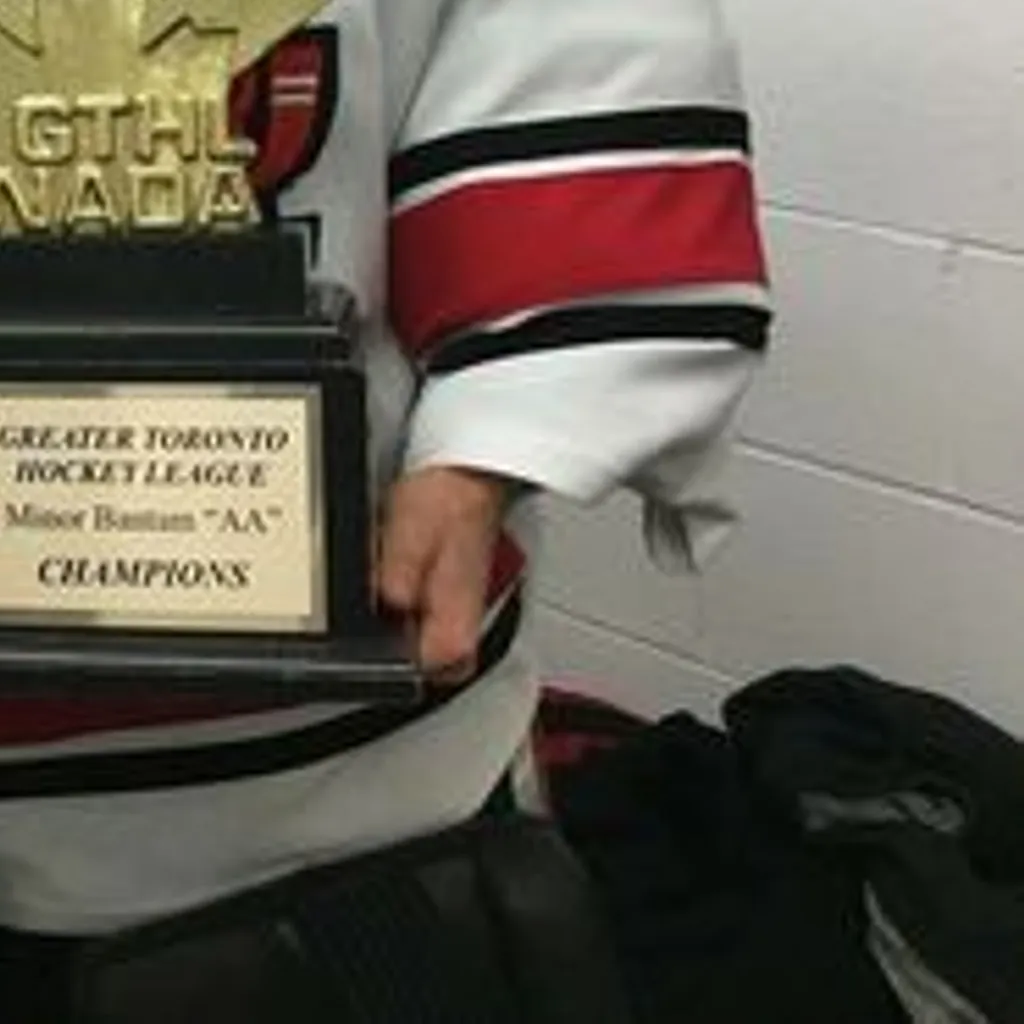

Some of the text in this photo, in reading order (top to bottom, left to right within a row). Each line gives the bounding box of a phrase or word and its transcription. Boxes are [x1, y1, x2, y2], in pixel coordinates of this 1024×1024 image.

[12, 92, 257, 163] GTHL
[142, 426, 290, 453] TORONTO
[14, 459, 272, 488] HOCKEY LEAGUE
[4, 502, 86, 528] Minor
[36, 557, 252, 589] CHAMPIONS
